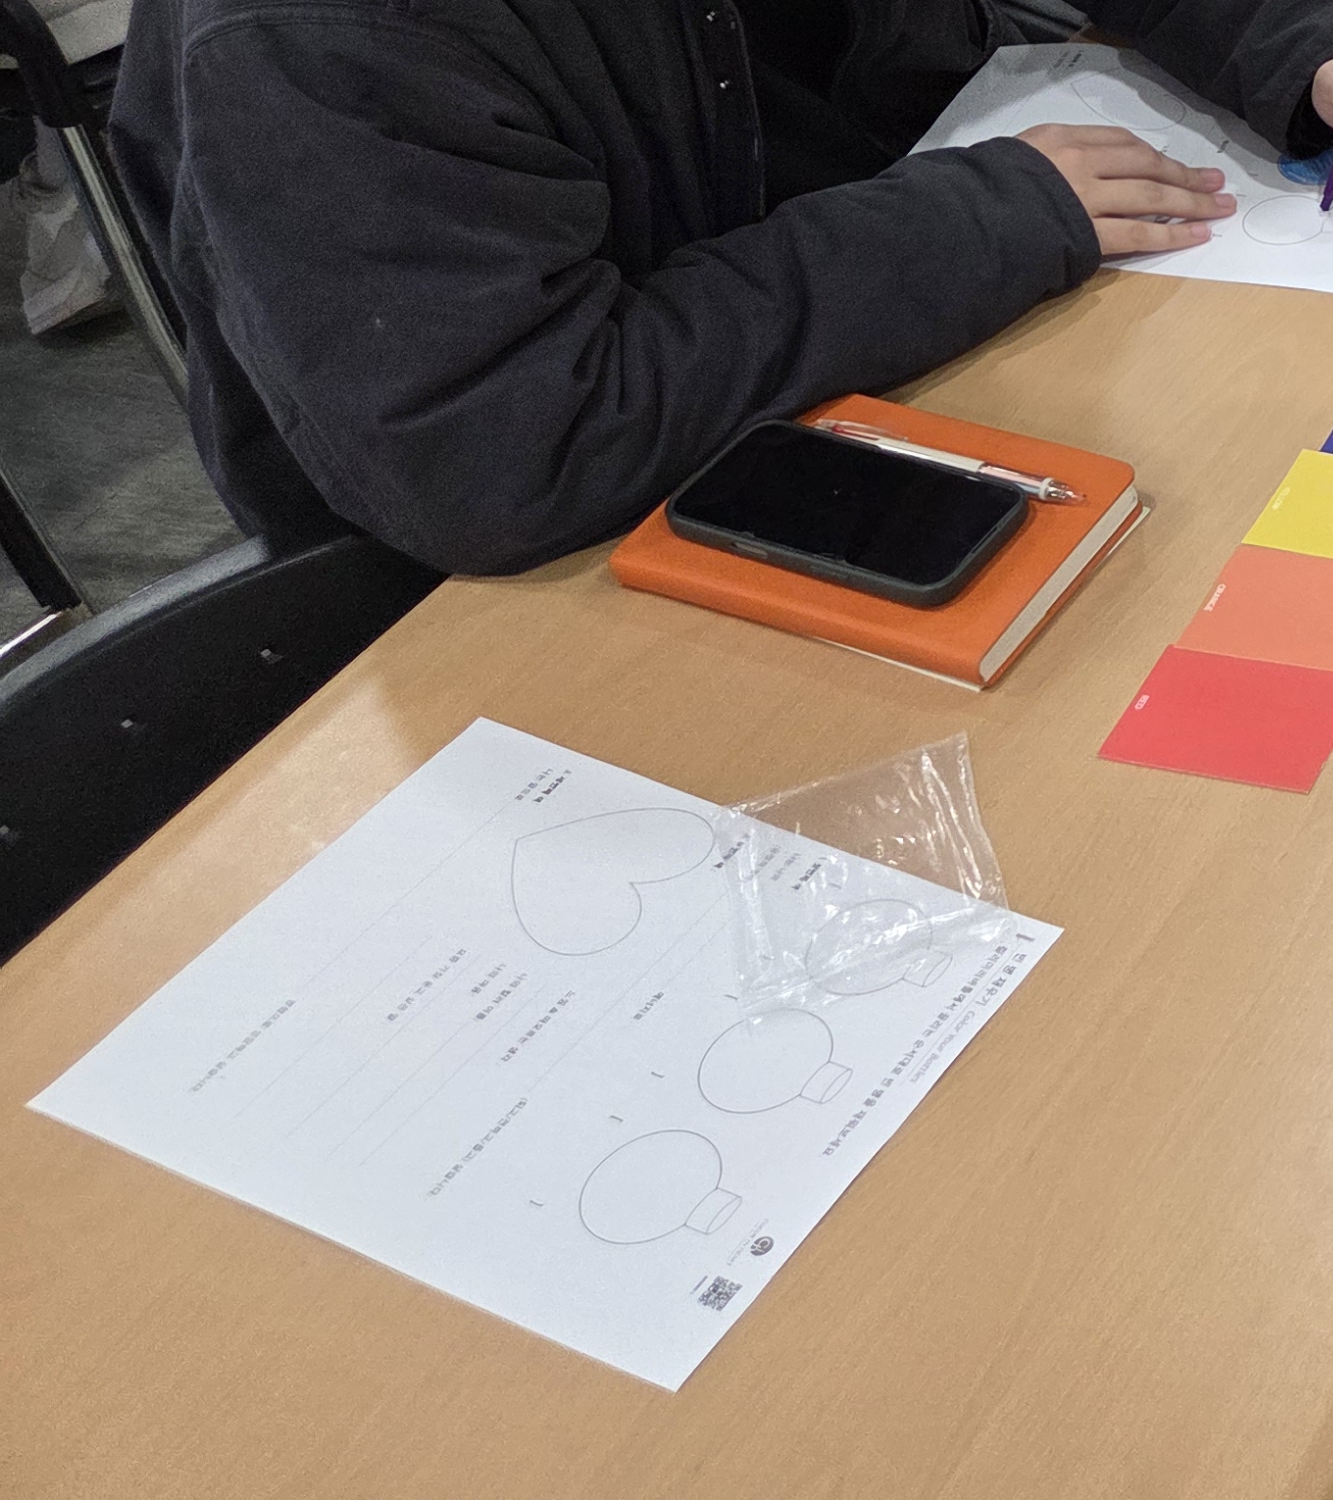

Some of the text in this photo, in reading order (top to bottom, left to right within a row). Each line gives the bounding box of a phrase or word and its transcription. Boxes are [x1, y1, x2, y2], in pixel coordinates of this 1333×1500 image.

[1204, 583, 1226, 611] ORANGE
[1012, 953, 1027, 963] 빈
[975, 977, 1007, 1006] 채우기
[954, 1010, 976, 1033] Color
[891, 1039, 924, 1075] 순서대로
[937, 1033, 957, 1053] Your
[910, 1052, 939, 1083] Bottles
